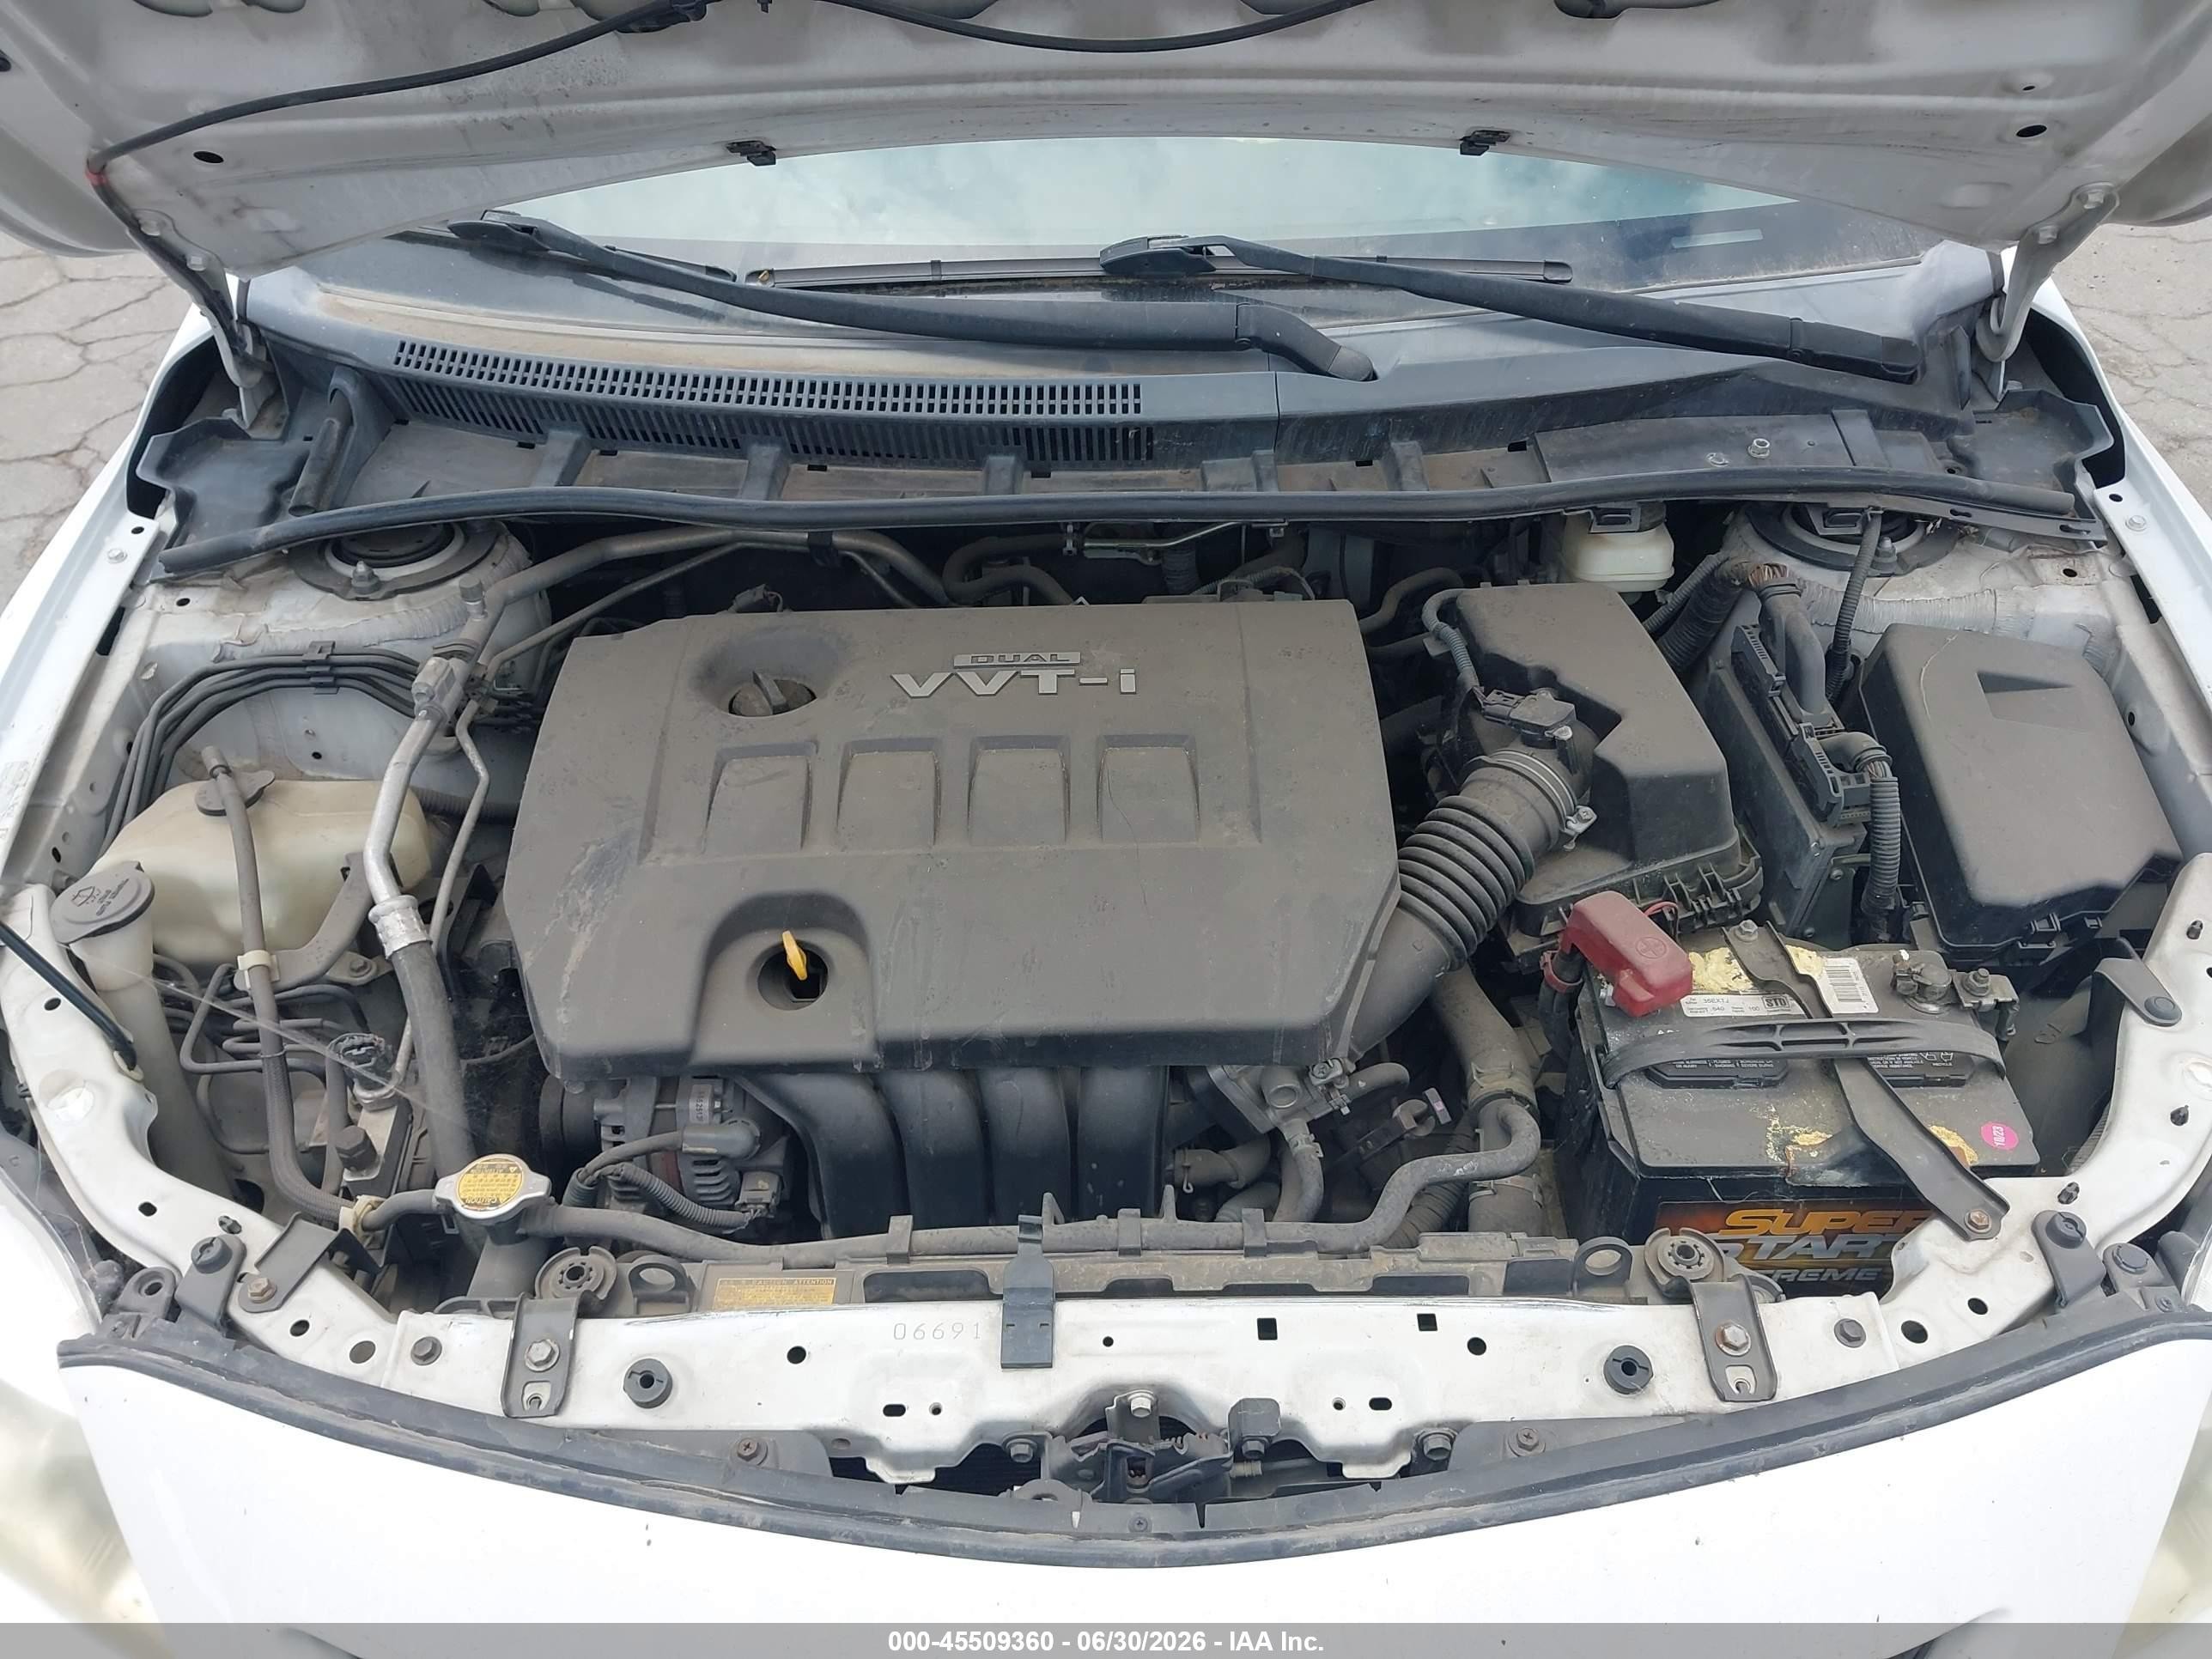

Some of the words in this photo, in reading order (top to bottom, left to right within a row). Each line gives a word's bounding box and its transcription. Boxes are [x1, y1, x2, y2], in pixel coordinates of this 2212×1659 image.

[971, 653, 1071, 664] DUAL
[890, 667, 1138, 698] VVT-i
[1765, 998, 1786, 1007] STD
[893, 1322, 981, 1340] 06691
